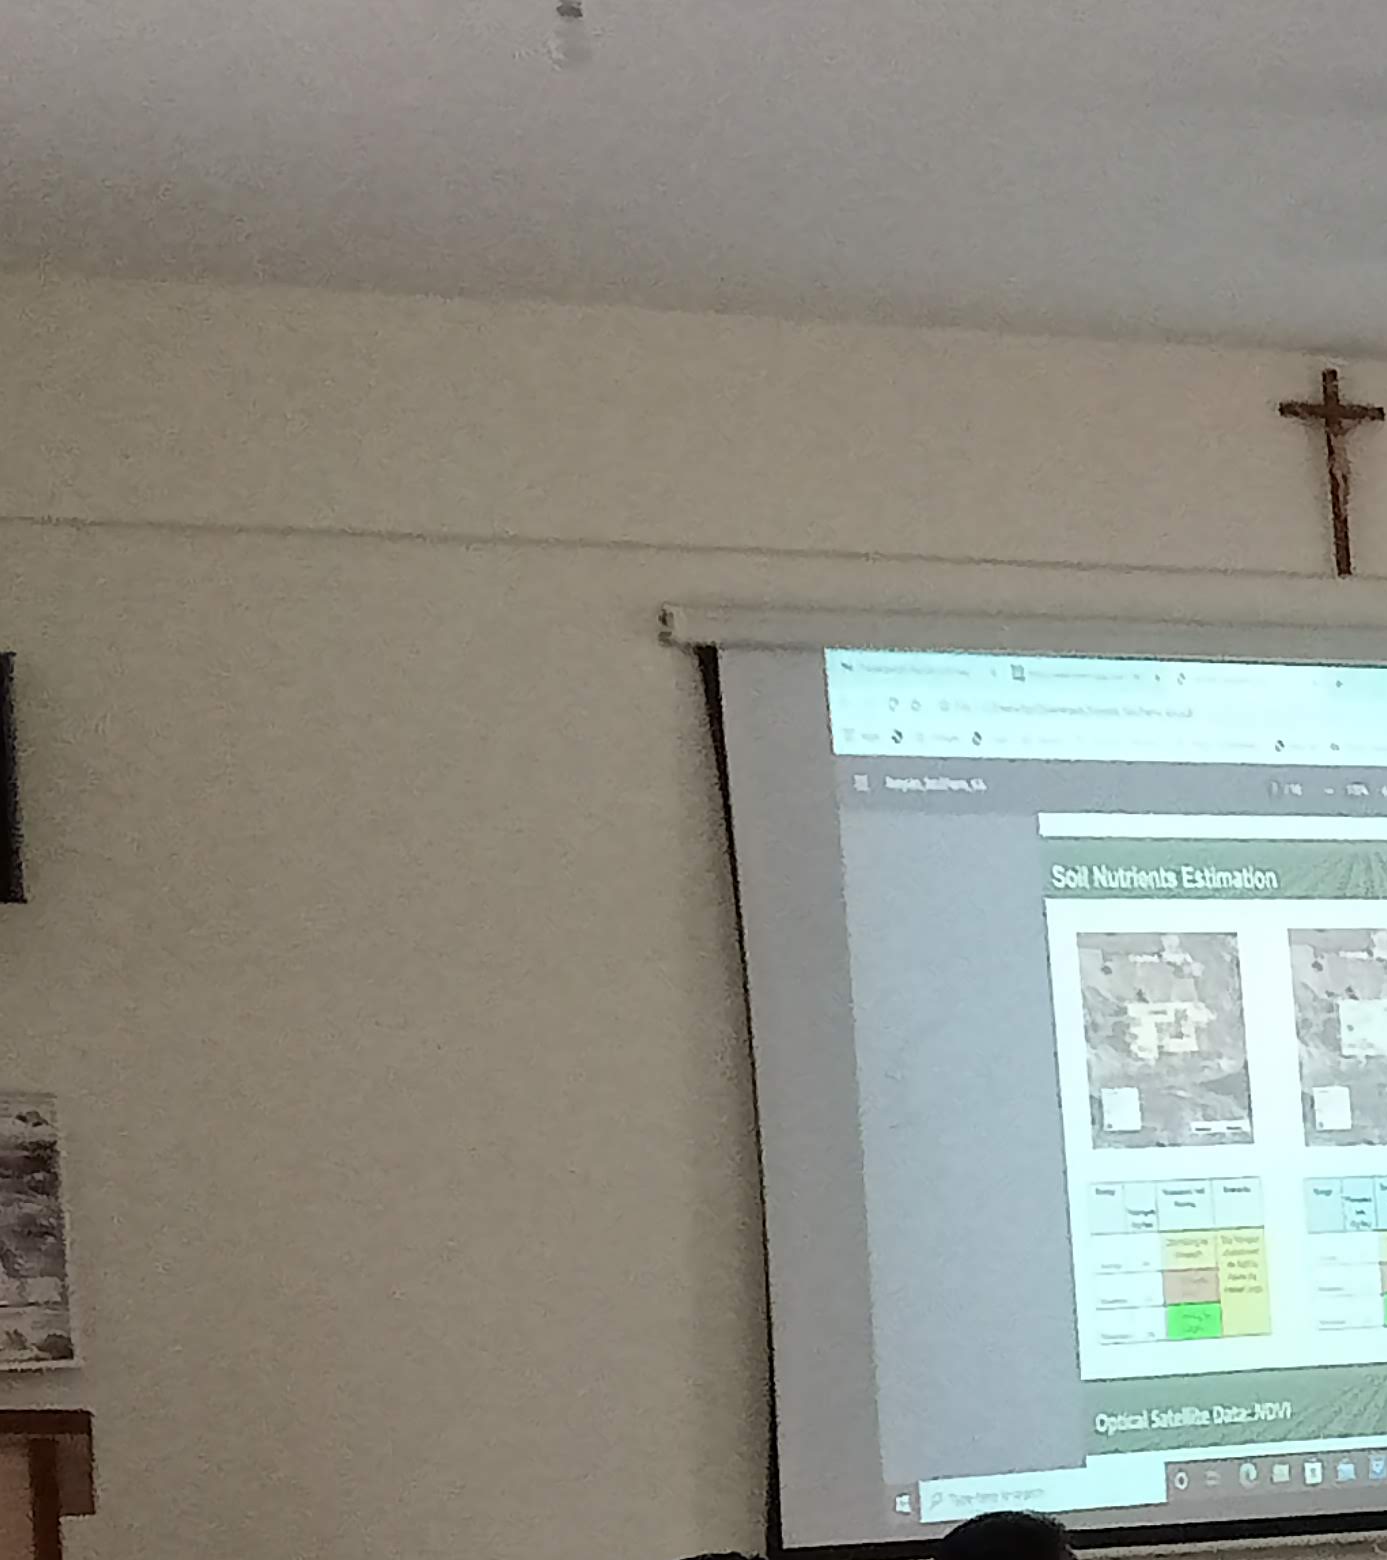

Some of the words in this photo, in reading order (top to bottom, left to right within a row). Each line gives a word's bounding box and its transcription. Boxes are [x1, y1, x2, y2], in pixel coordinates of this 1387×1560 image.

[1051, 864, 1089, 889] Soil
[1092, 864, 1178, 889] Nutrients
[1180, 865, 1278, 890] Estimation
[1095, 1410, 1149, 1437] Optical
[1151, 1406, 1210, 1428] Satellite
